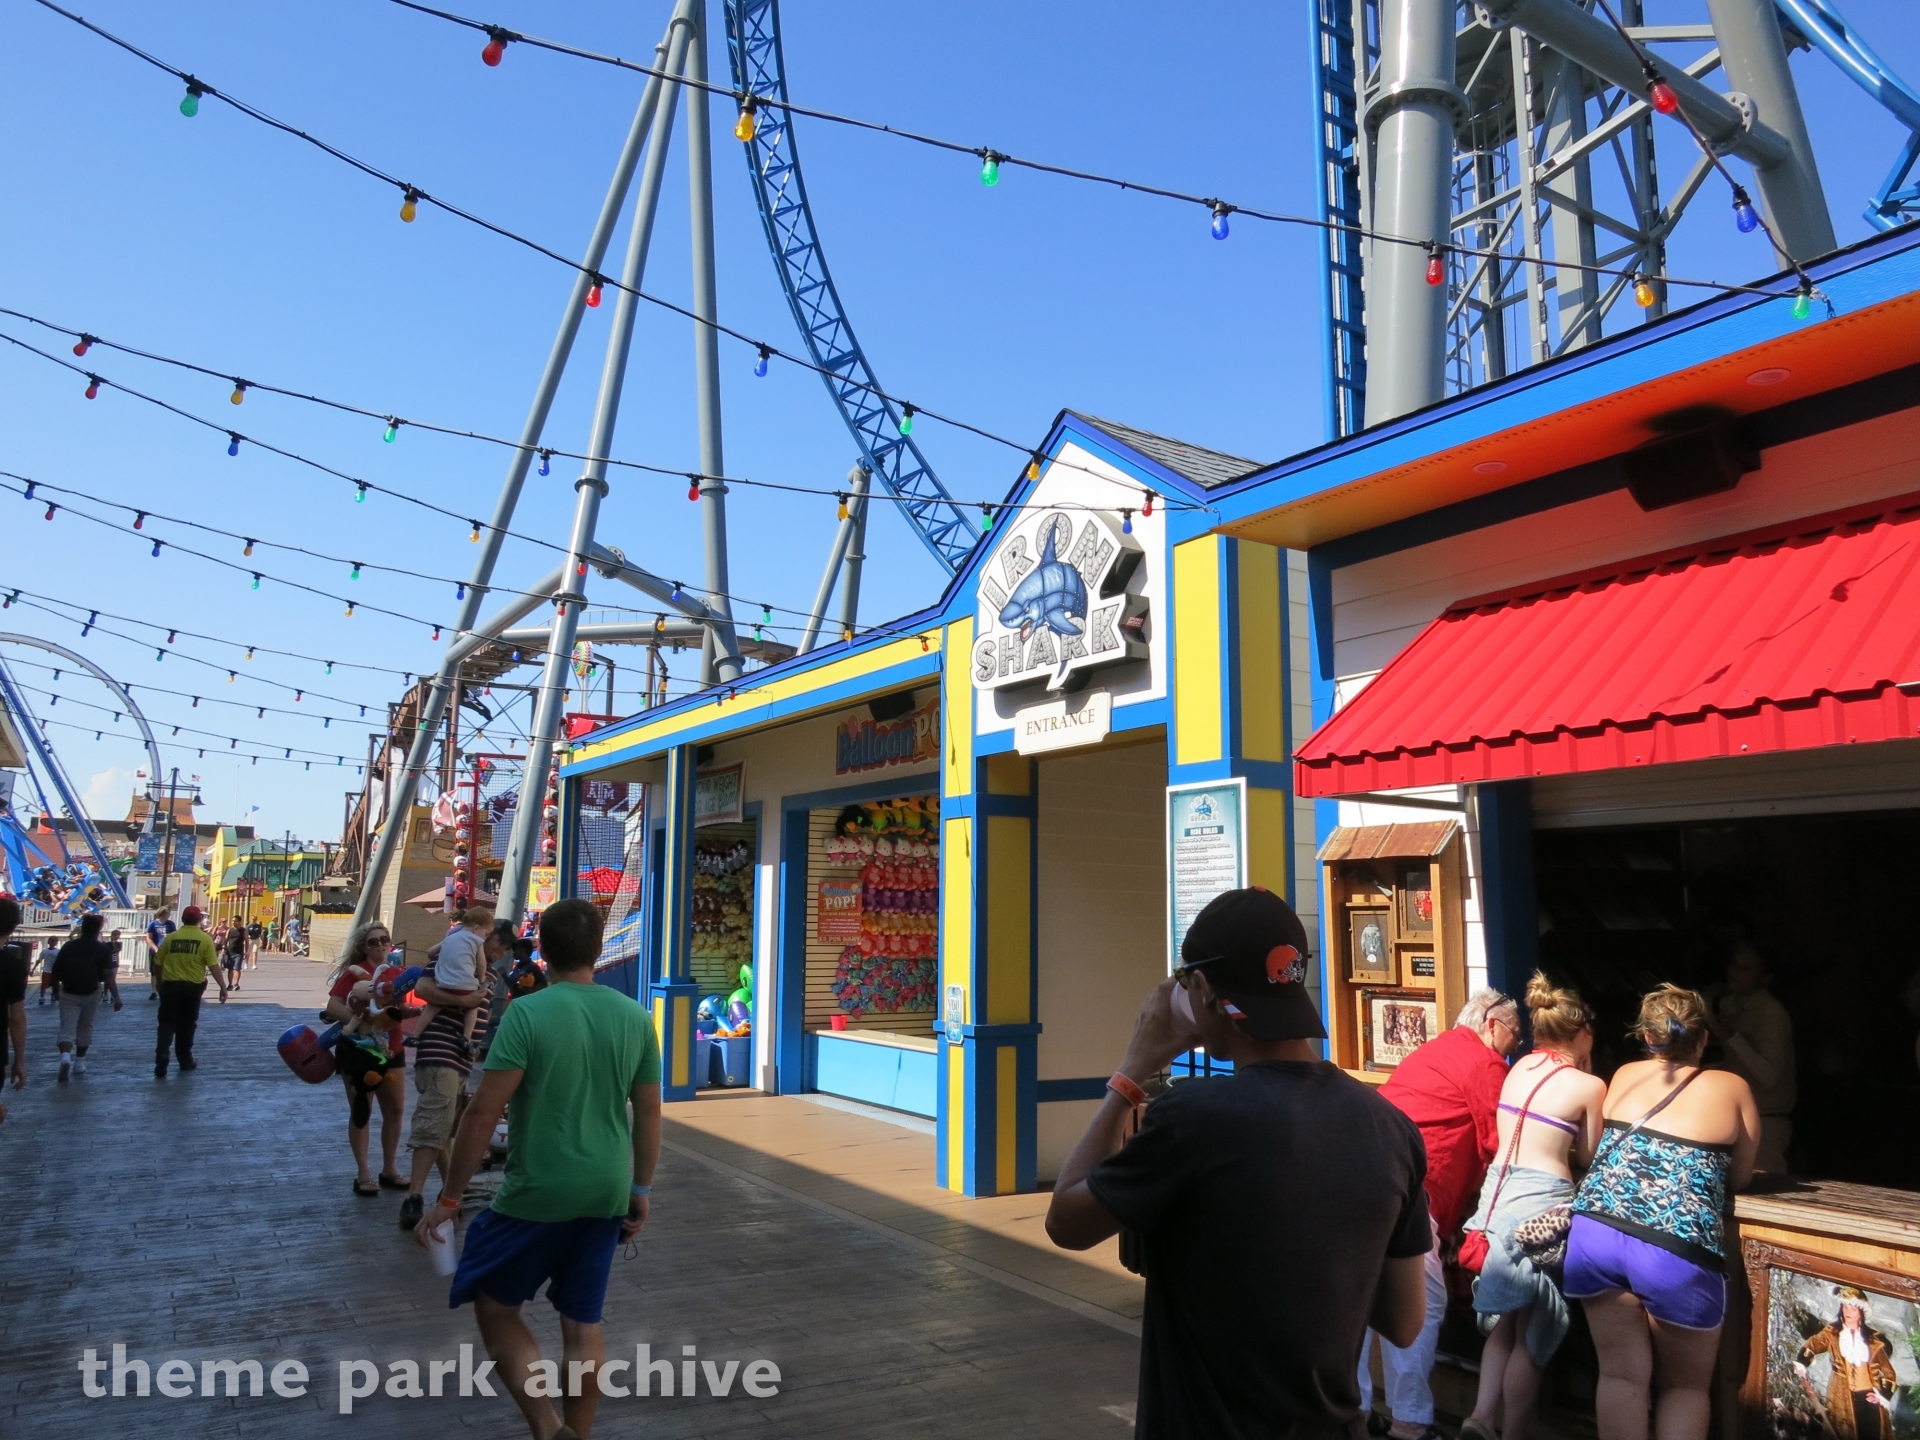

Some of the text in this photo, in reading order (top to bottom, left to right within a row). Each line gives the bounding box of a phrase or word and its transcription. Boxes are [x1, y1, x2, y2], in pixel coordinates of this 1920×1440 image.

[982, 511, 1115, 614] IRON
[975, 603, 1121, 683] SHARK
[1026, 708, 1096, 736] ENTRANCE
[837, 725, 914, 770] Balloon
[713, 772, 738, 791] WEIGHT
[1190, 826, 1218, 836] RIDE RULES
[824, 895, 856, 911] POP!
[170, 939, 201, 954] SECURITY
